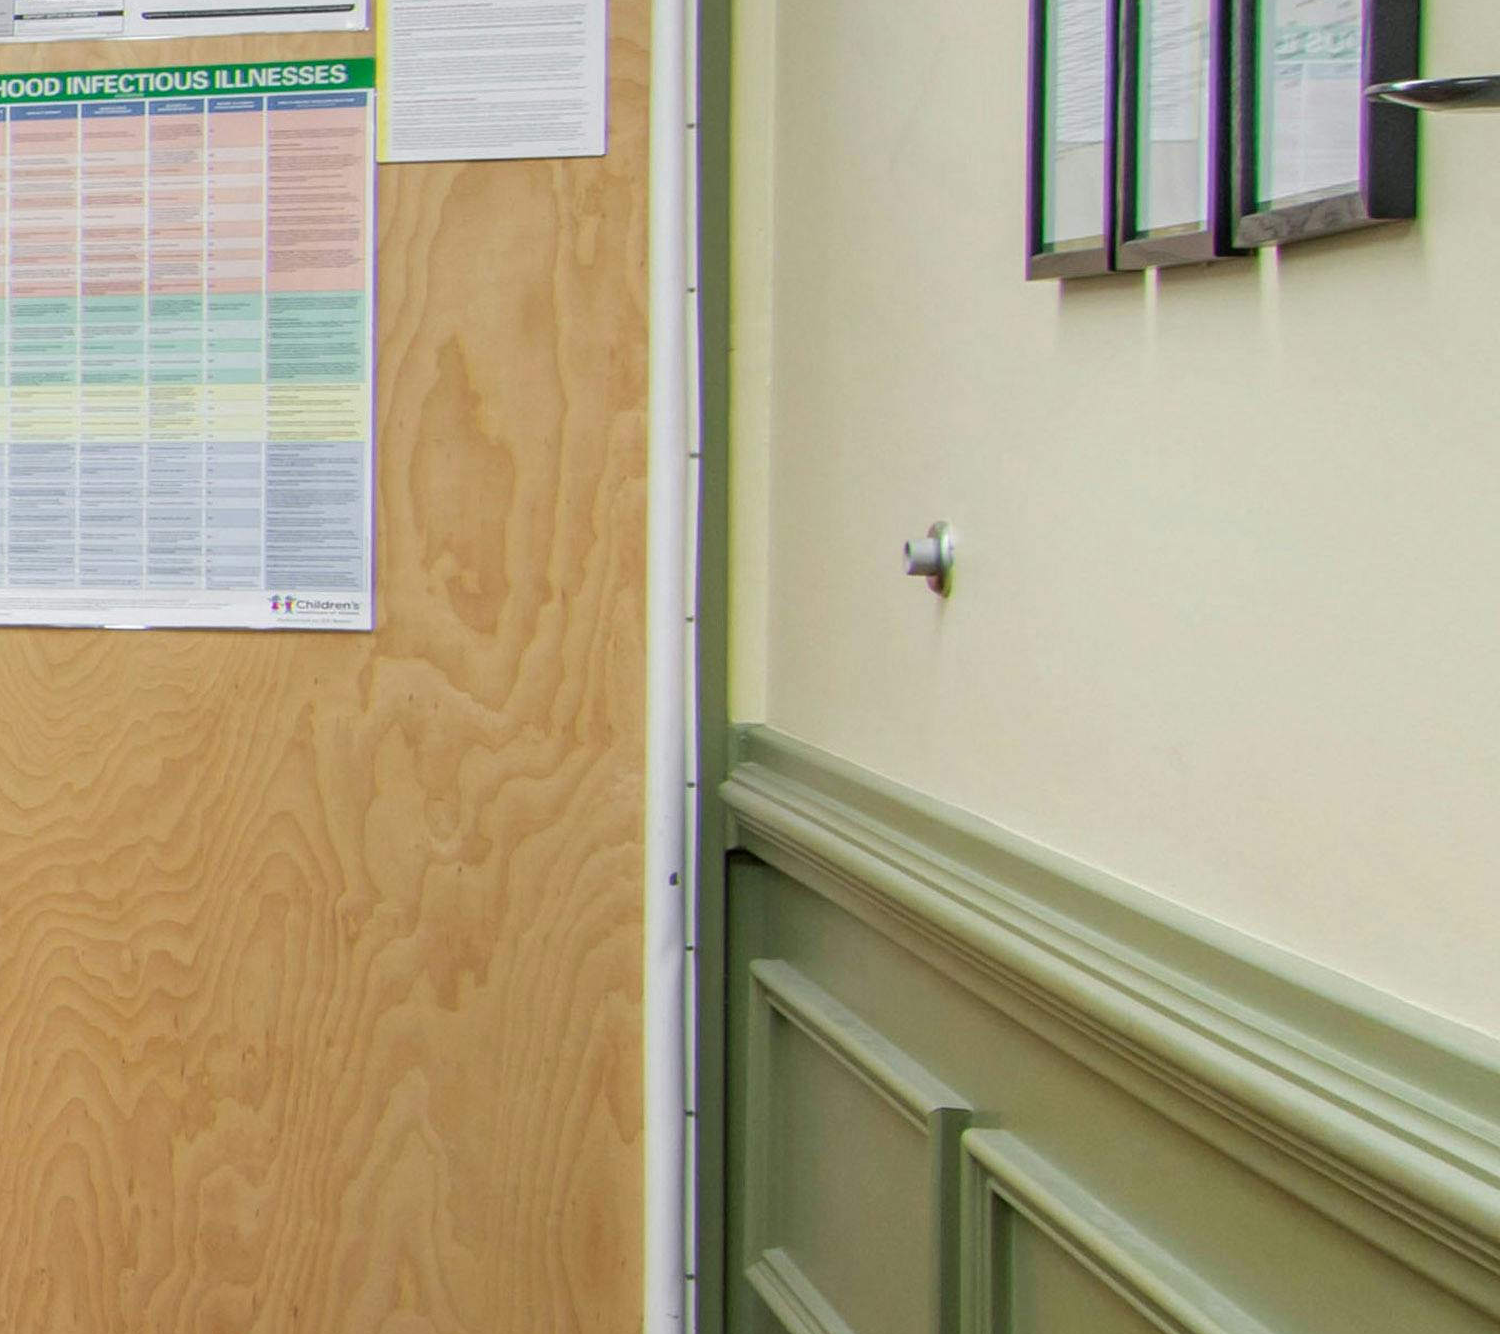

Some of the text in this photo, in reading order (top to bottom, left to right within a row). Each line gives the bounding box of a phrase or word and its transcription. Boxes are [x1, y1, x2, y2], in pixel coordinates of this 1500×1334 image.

[66, 70, 210, 97] INFECTIOUS
[214, 64, 348, 91] ILLNESSES
[297, 599, 360, 610] Children's
